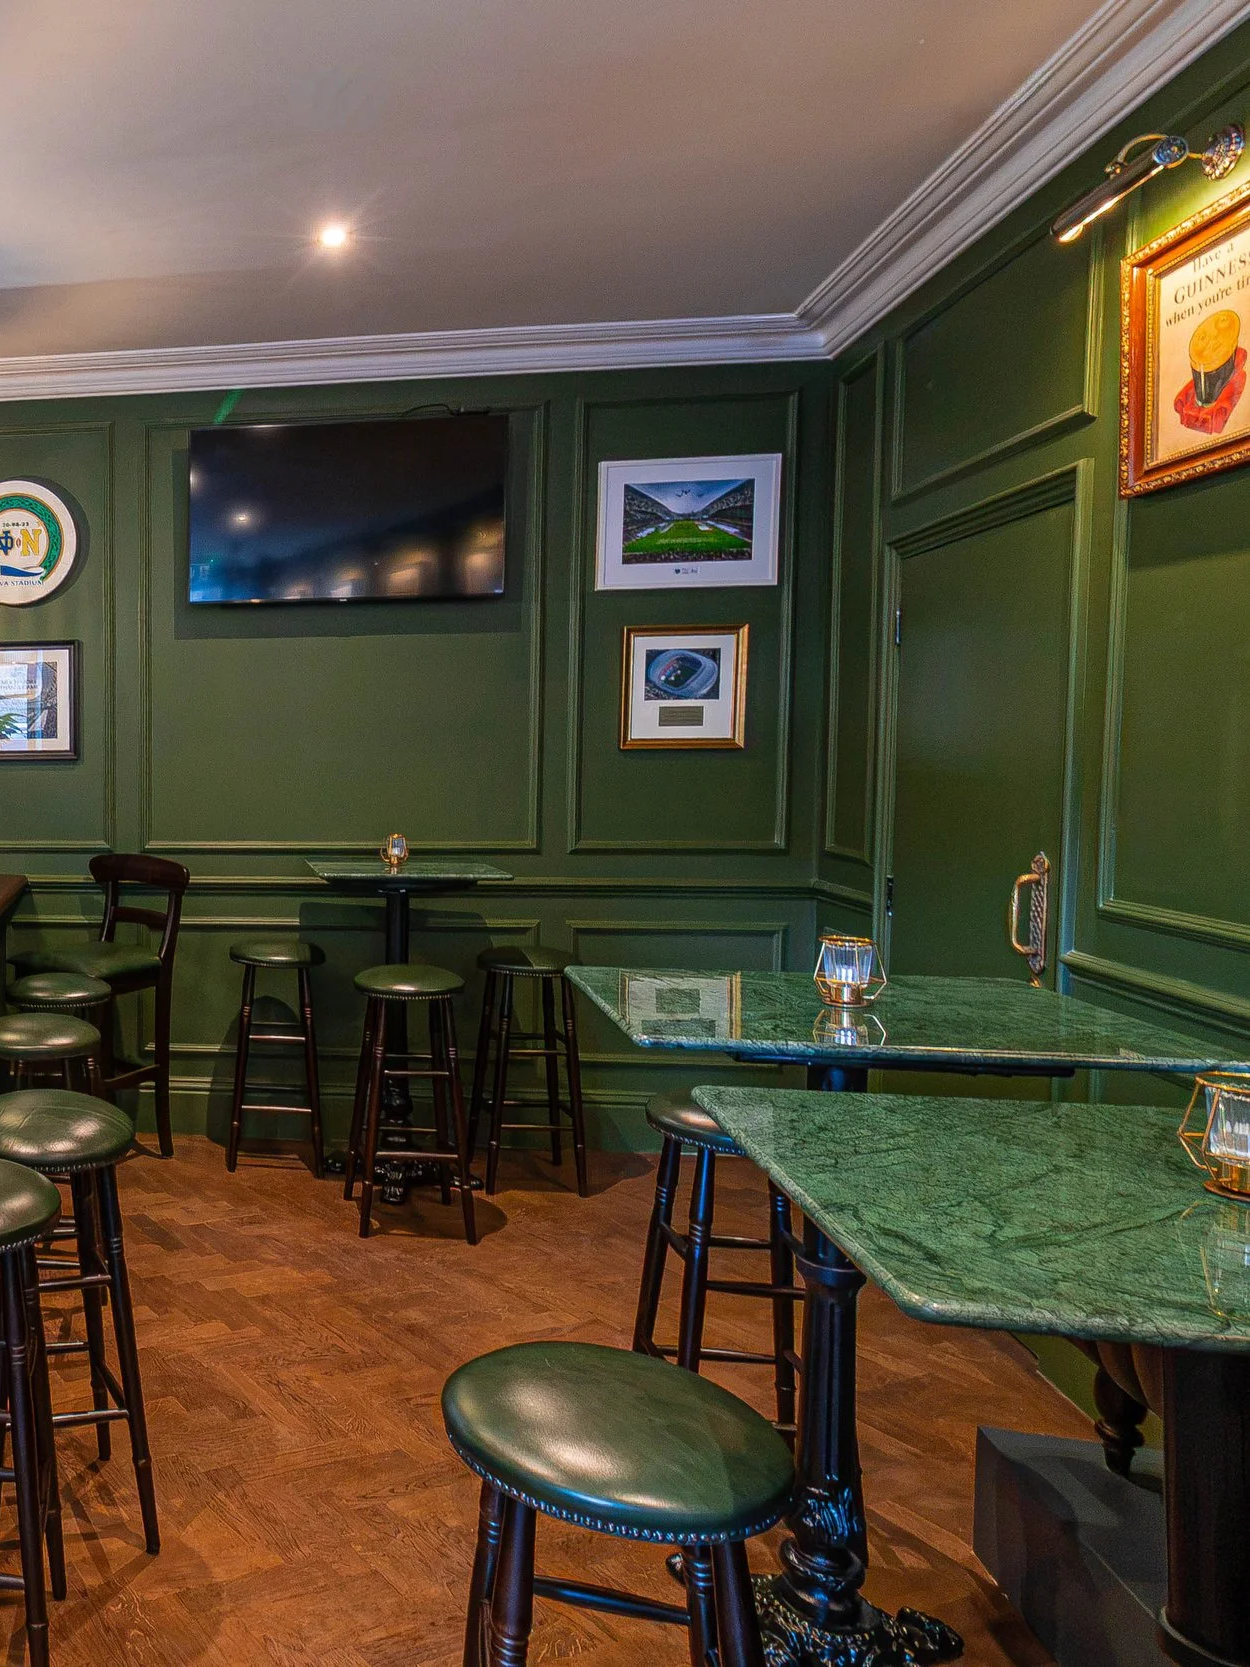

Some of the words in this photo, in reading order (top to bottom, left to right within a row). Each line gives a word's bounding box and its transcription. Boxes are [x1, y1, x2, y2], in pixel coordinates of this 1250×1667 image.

[1192, 249, 1221, 272] Have
[1227, 242, 1234, 254] a
[1174, 251, 1250, 304] GUINNES
[1165, 306, 1195, 328] when
[1197, 286, 1233, 316] you're
[20, 529, 42, 556] N
